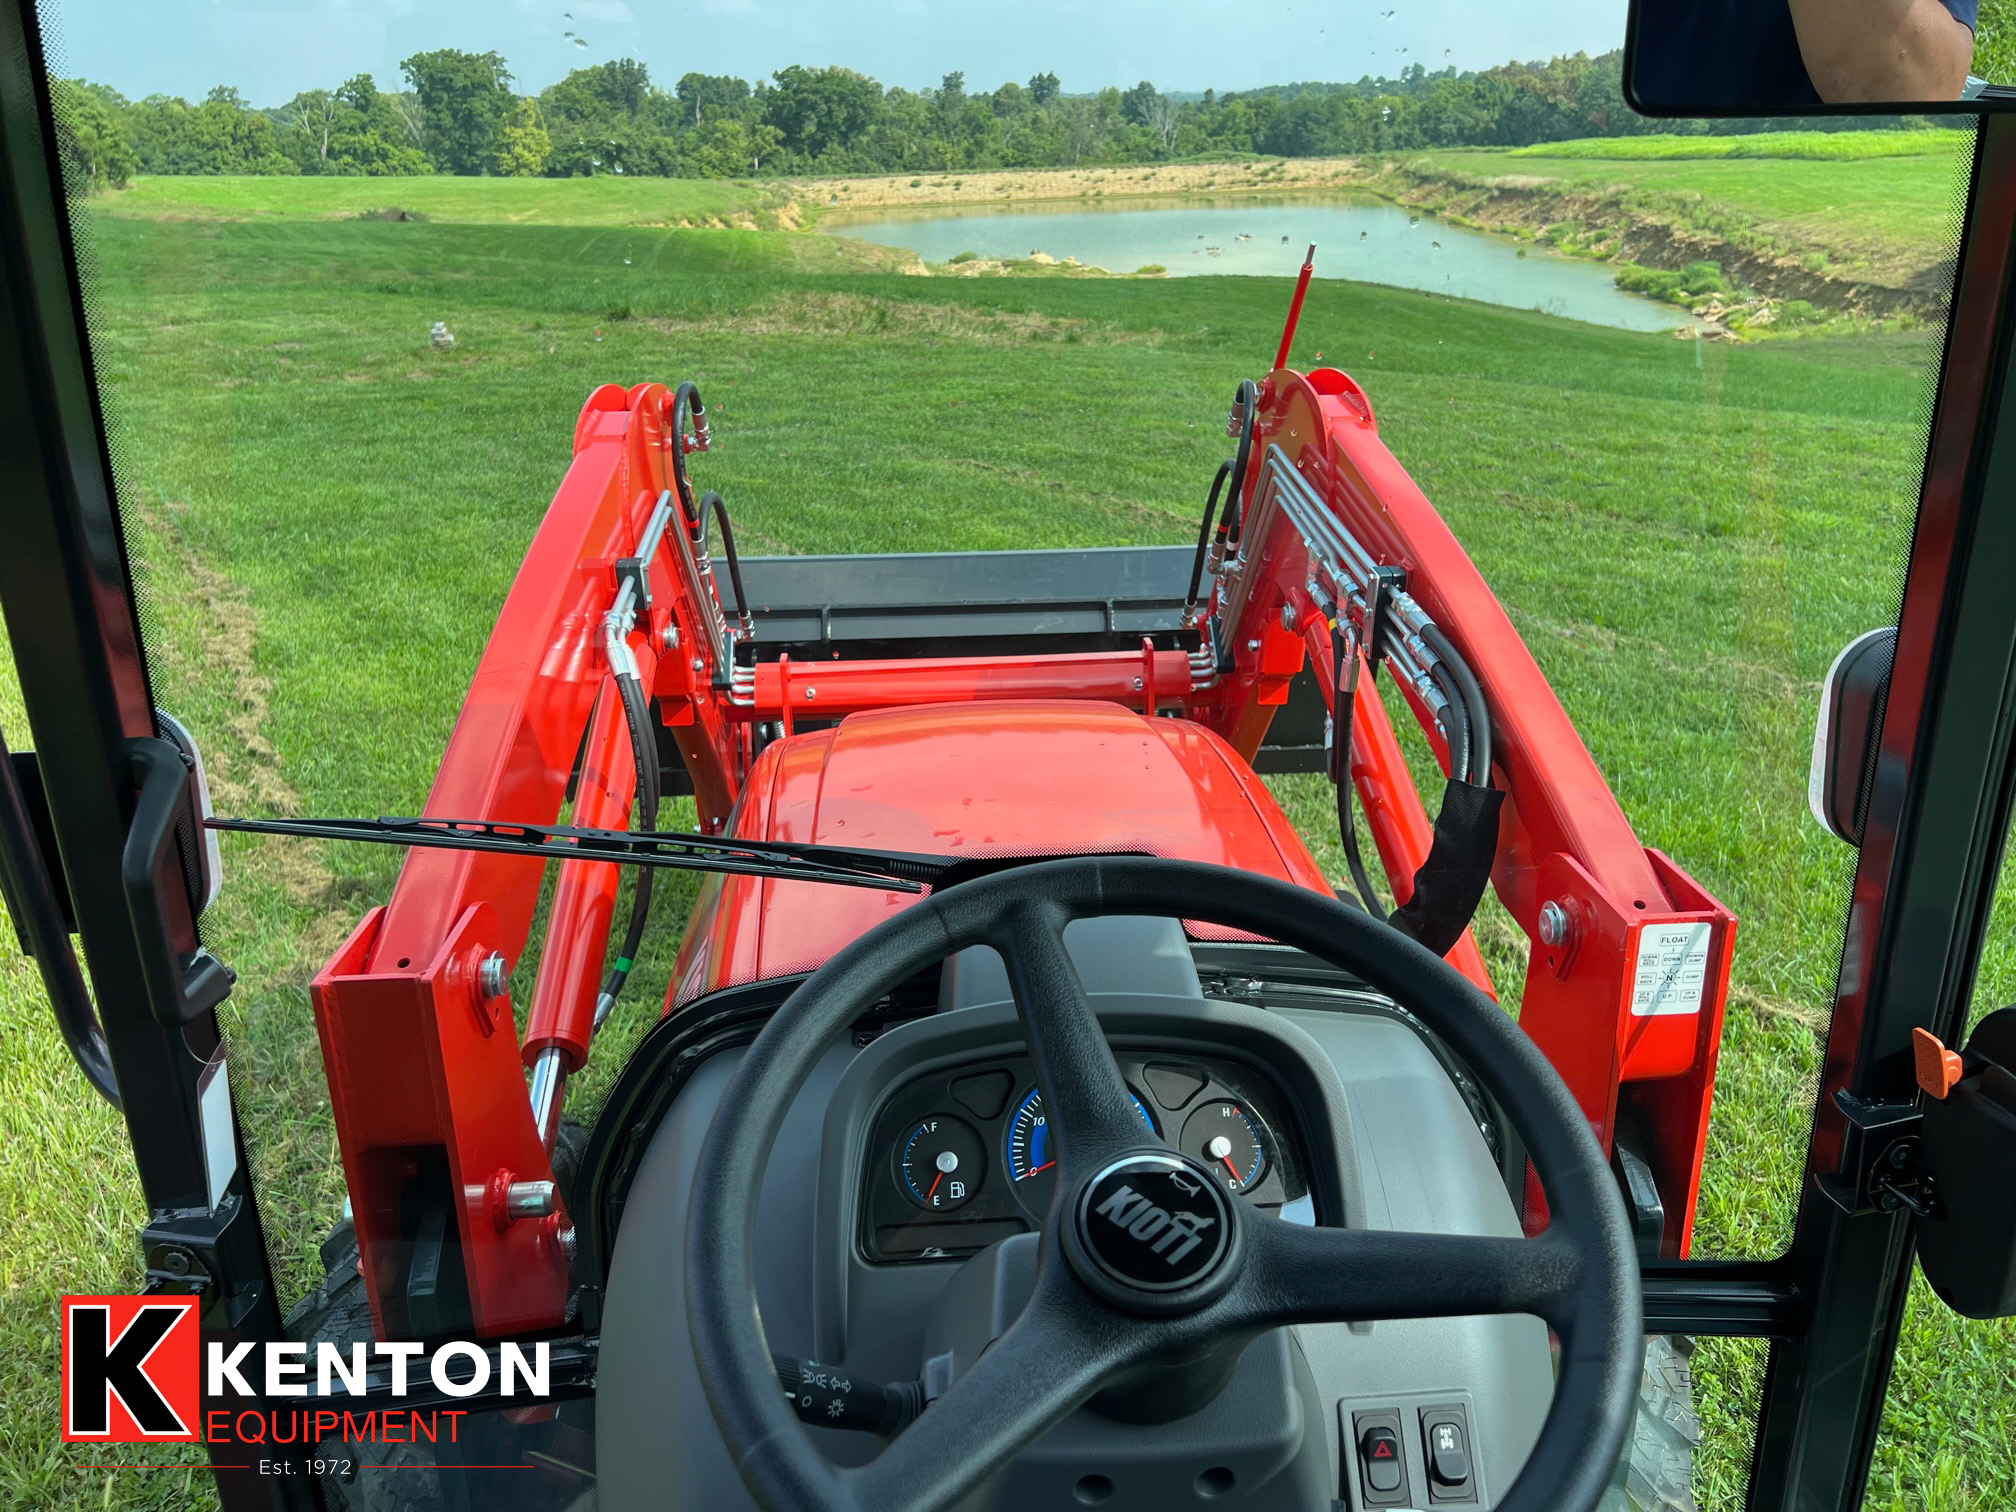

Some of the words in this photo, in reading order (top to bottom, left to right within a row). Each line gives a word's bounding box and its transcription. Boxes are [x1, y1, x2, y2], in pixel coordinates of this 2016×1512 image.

[1222, 1107, 1230, 1117] H
[1032, 1116, 1046, 1126] 10
[931, 1122, 938, 1132] F
[1228, 1179, 1237, 1190] C
[933, 1195, 940, 1206] E
[1095, 1184, 1203, 1266] KIOTI
